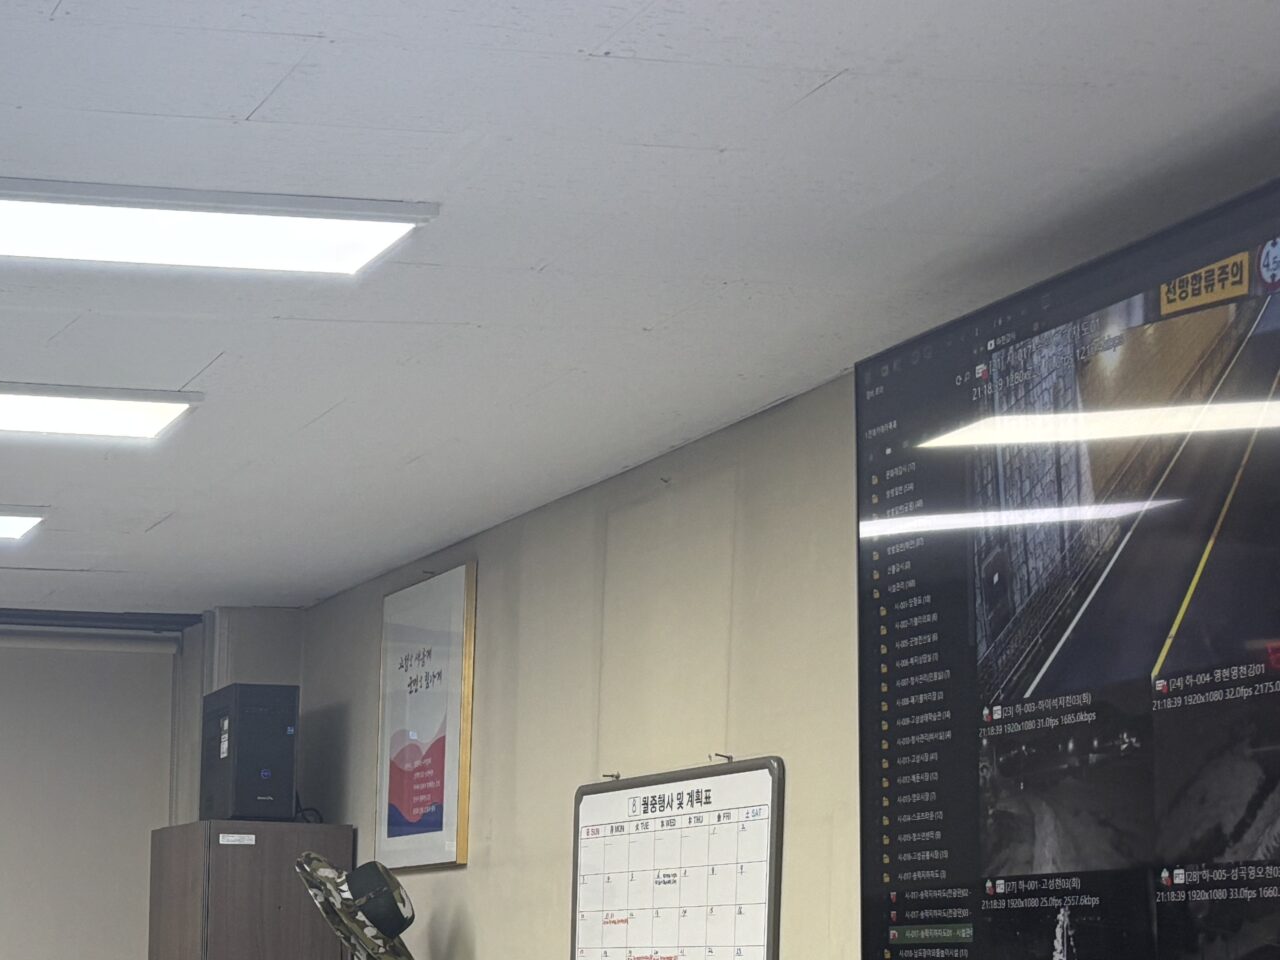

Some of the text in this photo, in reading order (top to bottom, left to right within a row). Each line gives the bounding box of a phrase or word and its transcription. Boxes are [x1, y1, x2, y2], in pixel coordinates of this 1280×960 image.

[1169, 677, 1184, 691] [24]
[1152, 696, 1182, 711] 21:18:39
[1184, 690, 1223, 705] 1920x1080
[1225, 686, 1253, 700] 32.0fps
[979, 725, 1003, 738] 21:18:39
[1004, 720, 1036, 734] 1920x1080
[641, 792, 674, 814] 월중행사
[677, 790, 684, 810] 및
[686, 788, 712, 808] 계획표
[1185, 871, 1200, 884] [28]
[1005, 882, 1017, 893] [27]
[1156, 890, 1185, 902] 21:18:39
[1188, 888, 1227, 901] 1920x1080
[1229, 887, 1257, 901] 33.0fps
[982, 899, 1005, 910] 21:18:39
[1007, 898, 1039, 908] 1920x1080
[1040, 896, 1062, 908] 25.0fps
